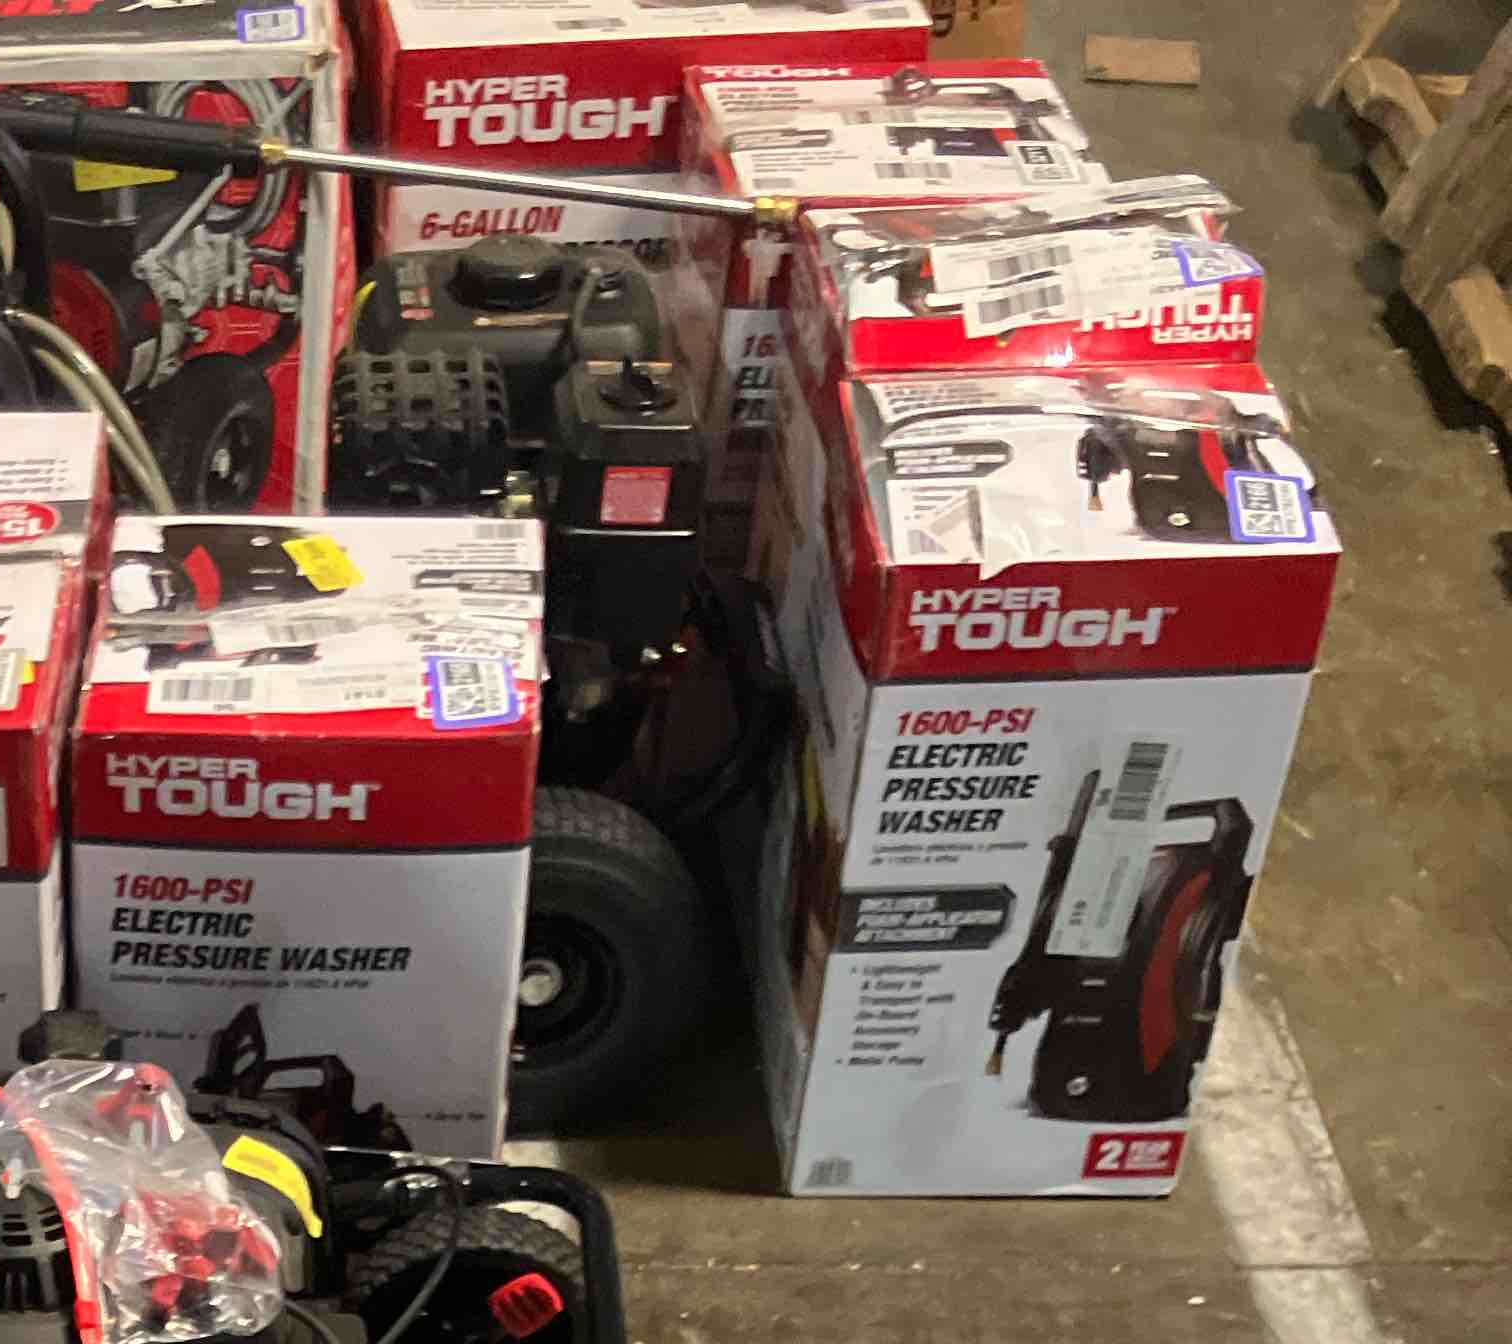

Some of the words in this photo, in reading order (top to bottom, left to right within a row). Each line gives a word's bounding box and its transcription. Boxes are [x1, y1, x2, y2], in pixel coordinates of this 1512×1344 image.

[425, 75, 568, 106] HYPER
[425, 96, 672, 148] TOUGH
[420, 205, 564, 240] 6-GALLON
[1151, 325, 1254, 345] HYPER
[909, 587, 1061, 612] HYPER
[910, 607, 1167, 651] TOUGH
[895, 707, 1037, 737] 1600-PSI
[105, 752, 258, 781] HYPER
[888, 742, 1030, 770] ELECTRIC
[106, 776, 372, 821] TOUGH
[882, 773, 1042, 802] PRESSURE
[878, 809, 1005, 834] WASHER
[113, 873, 256, 905] 1600-PSI
[110, 907, 254, 939] ELECTRIC
[110, 940, 270, 972] PRESSURE
[279, 945, 412, 973] WASHER
[1095, 1137, 1125, 1171] 2
